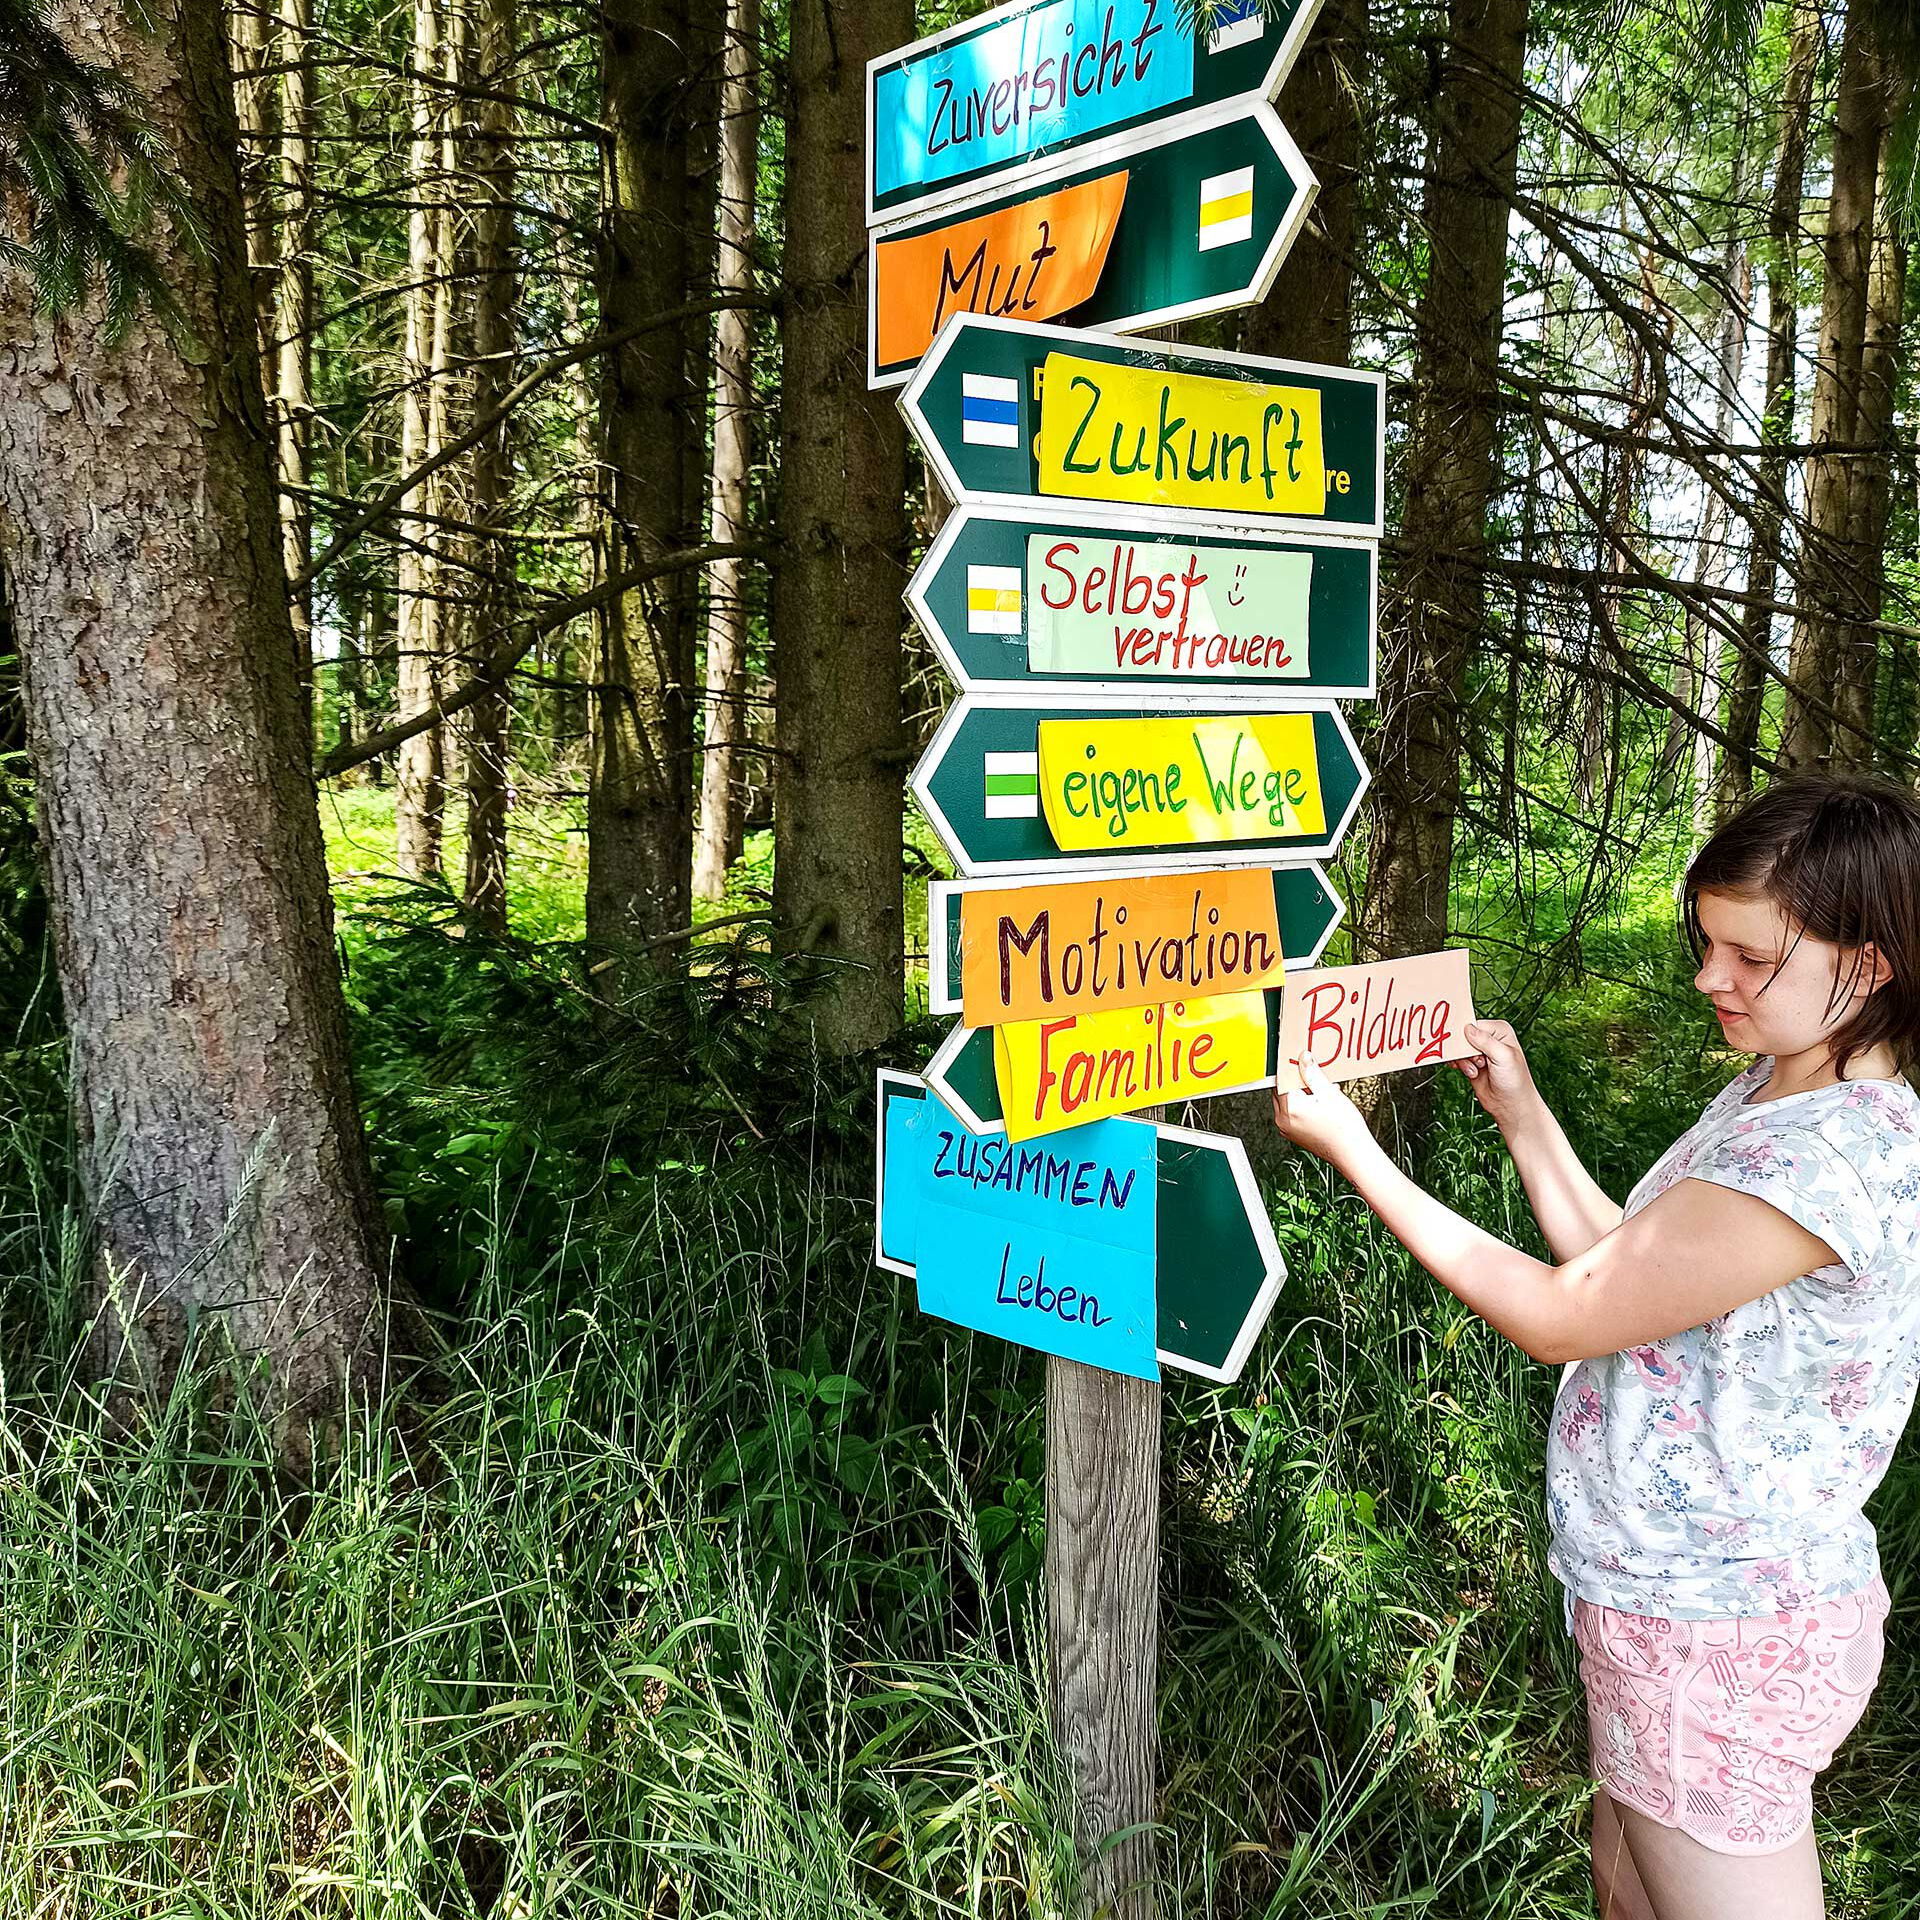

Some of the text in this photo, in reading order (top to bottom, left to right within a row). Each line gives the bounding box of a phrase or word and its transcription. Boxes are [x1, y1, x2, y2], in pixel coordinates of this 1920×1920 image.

[927, 0, 1163, 155] Zuversicht
[932, 221, 1057, 336] Mut
[1062, 375, 1303, 499] Zukunft
[1040, 542, 1208, 619] Selbst
[1114, 617, 1292, 670] vertrauen
[1063, 732, 1307, 837] eigene Wege
[998, 890, 1276, 1006] Motivation
[1034, 1002, 1228, 1121] Familie
[1289, 977, 1452, 1068] Bildung
[932, 1131, 1136, 1209] ZUSAMMEN
[996, 1242, 1113, 1328] Leben
